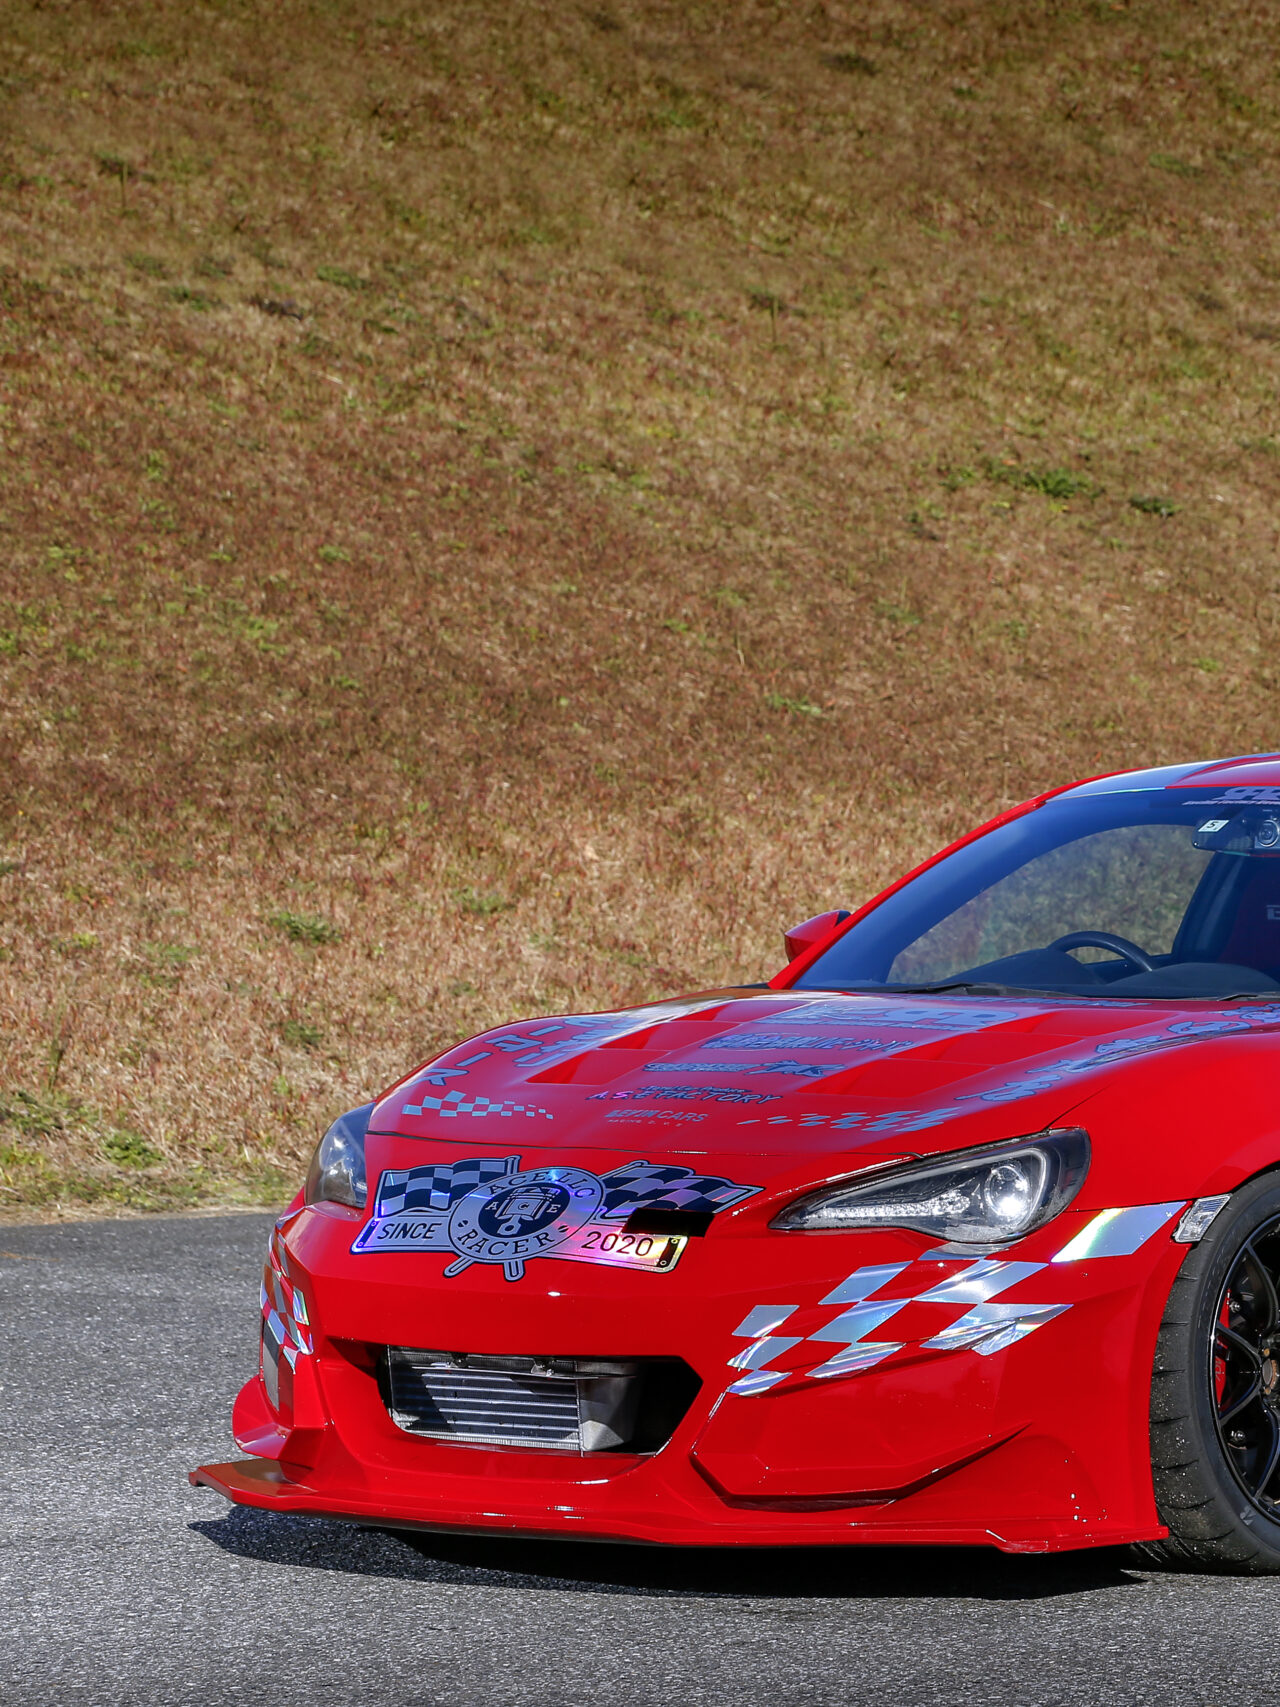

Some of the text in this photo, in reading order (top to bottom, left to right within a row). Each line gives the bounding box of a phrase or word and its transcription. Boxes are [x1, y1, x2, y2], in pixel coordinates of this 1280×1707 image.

[654, 1090, 783, 1104] FACTORY
[604, 1109, 709, 1122] LEVIN CARS
[377, 1222, 443, 1240] SINCE
[457, 1229, 555, 1256] RACER
[580, 1230, 655, 1257] 2020
